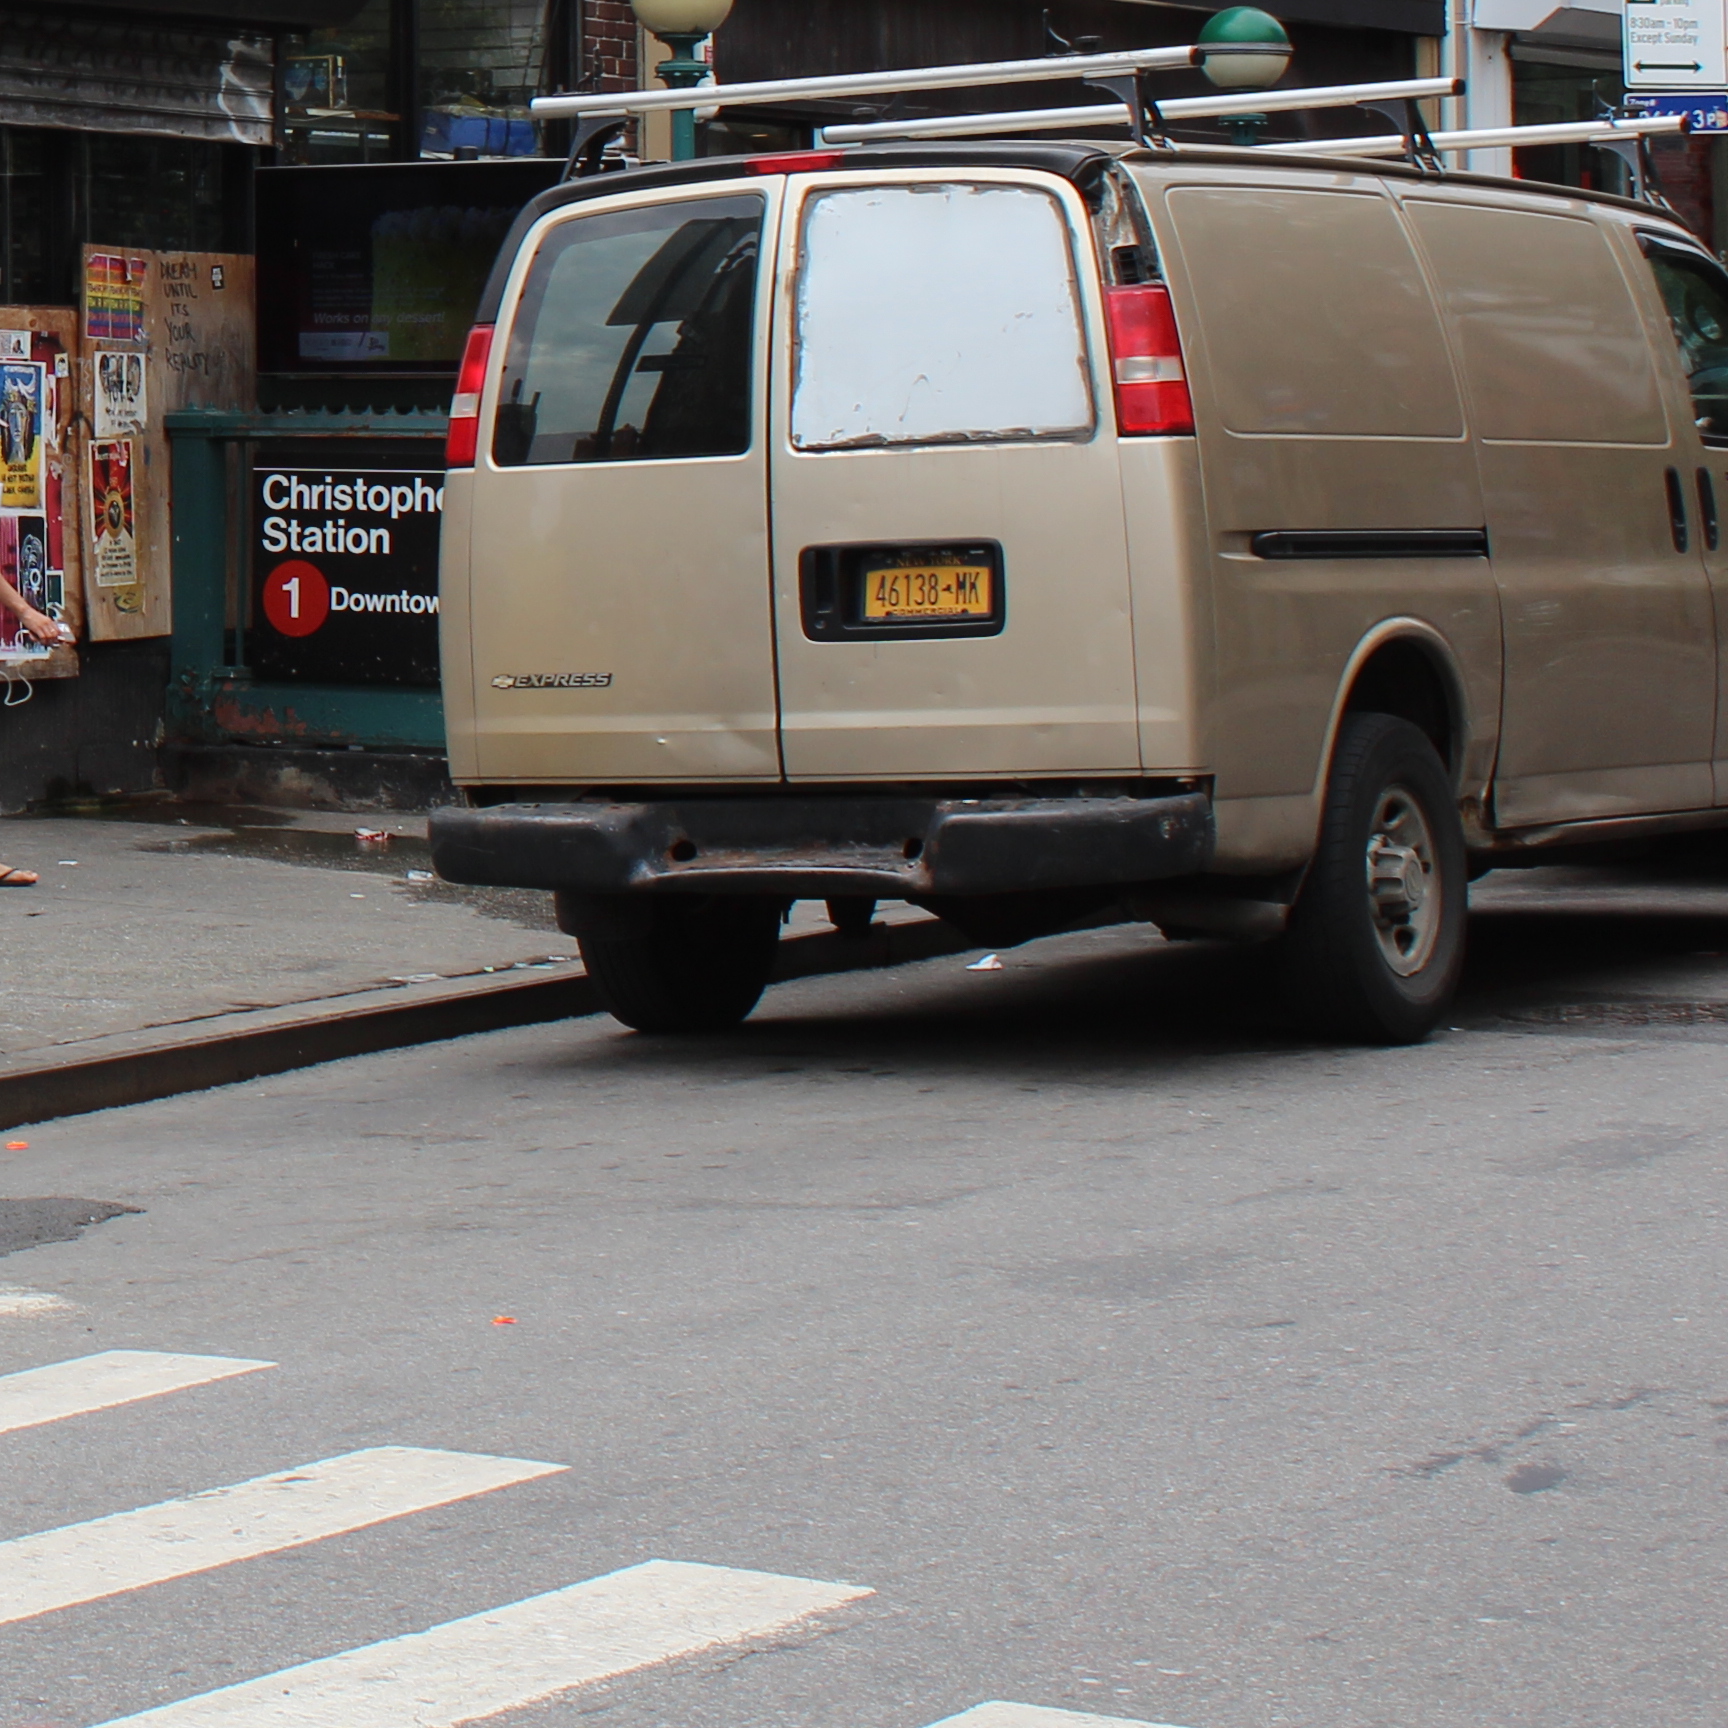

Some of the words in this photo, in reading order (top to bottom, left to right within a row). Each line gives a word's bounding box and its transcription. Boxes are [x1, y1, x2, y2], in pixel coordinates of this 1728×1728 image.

[1630, 17, 1665, 29] 8:30am
[1673, 18, 1698, 30] 10pm
[1630, 33, 1662, 44] Except
[1663, 33, 1698, 45] Sunday
[313, 312, 350, 325] Works
[353, 314, 369, 324] on
[262, 516, 390, 555] Station
[875, 573, 940, 608] 46138
[955, 571, 981, 605] MK
[282, 577, 300, 619] 1
[891, 606, 962, 617] COMMERCIAL
[514, 673, 613, 689] EXPRESS
